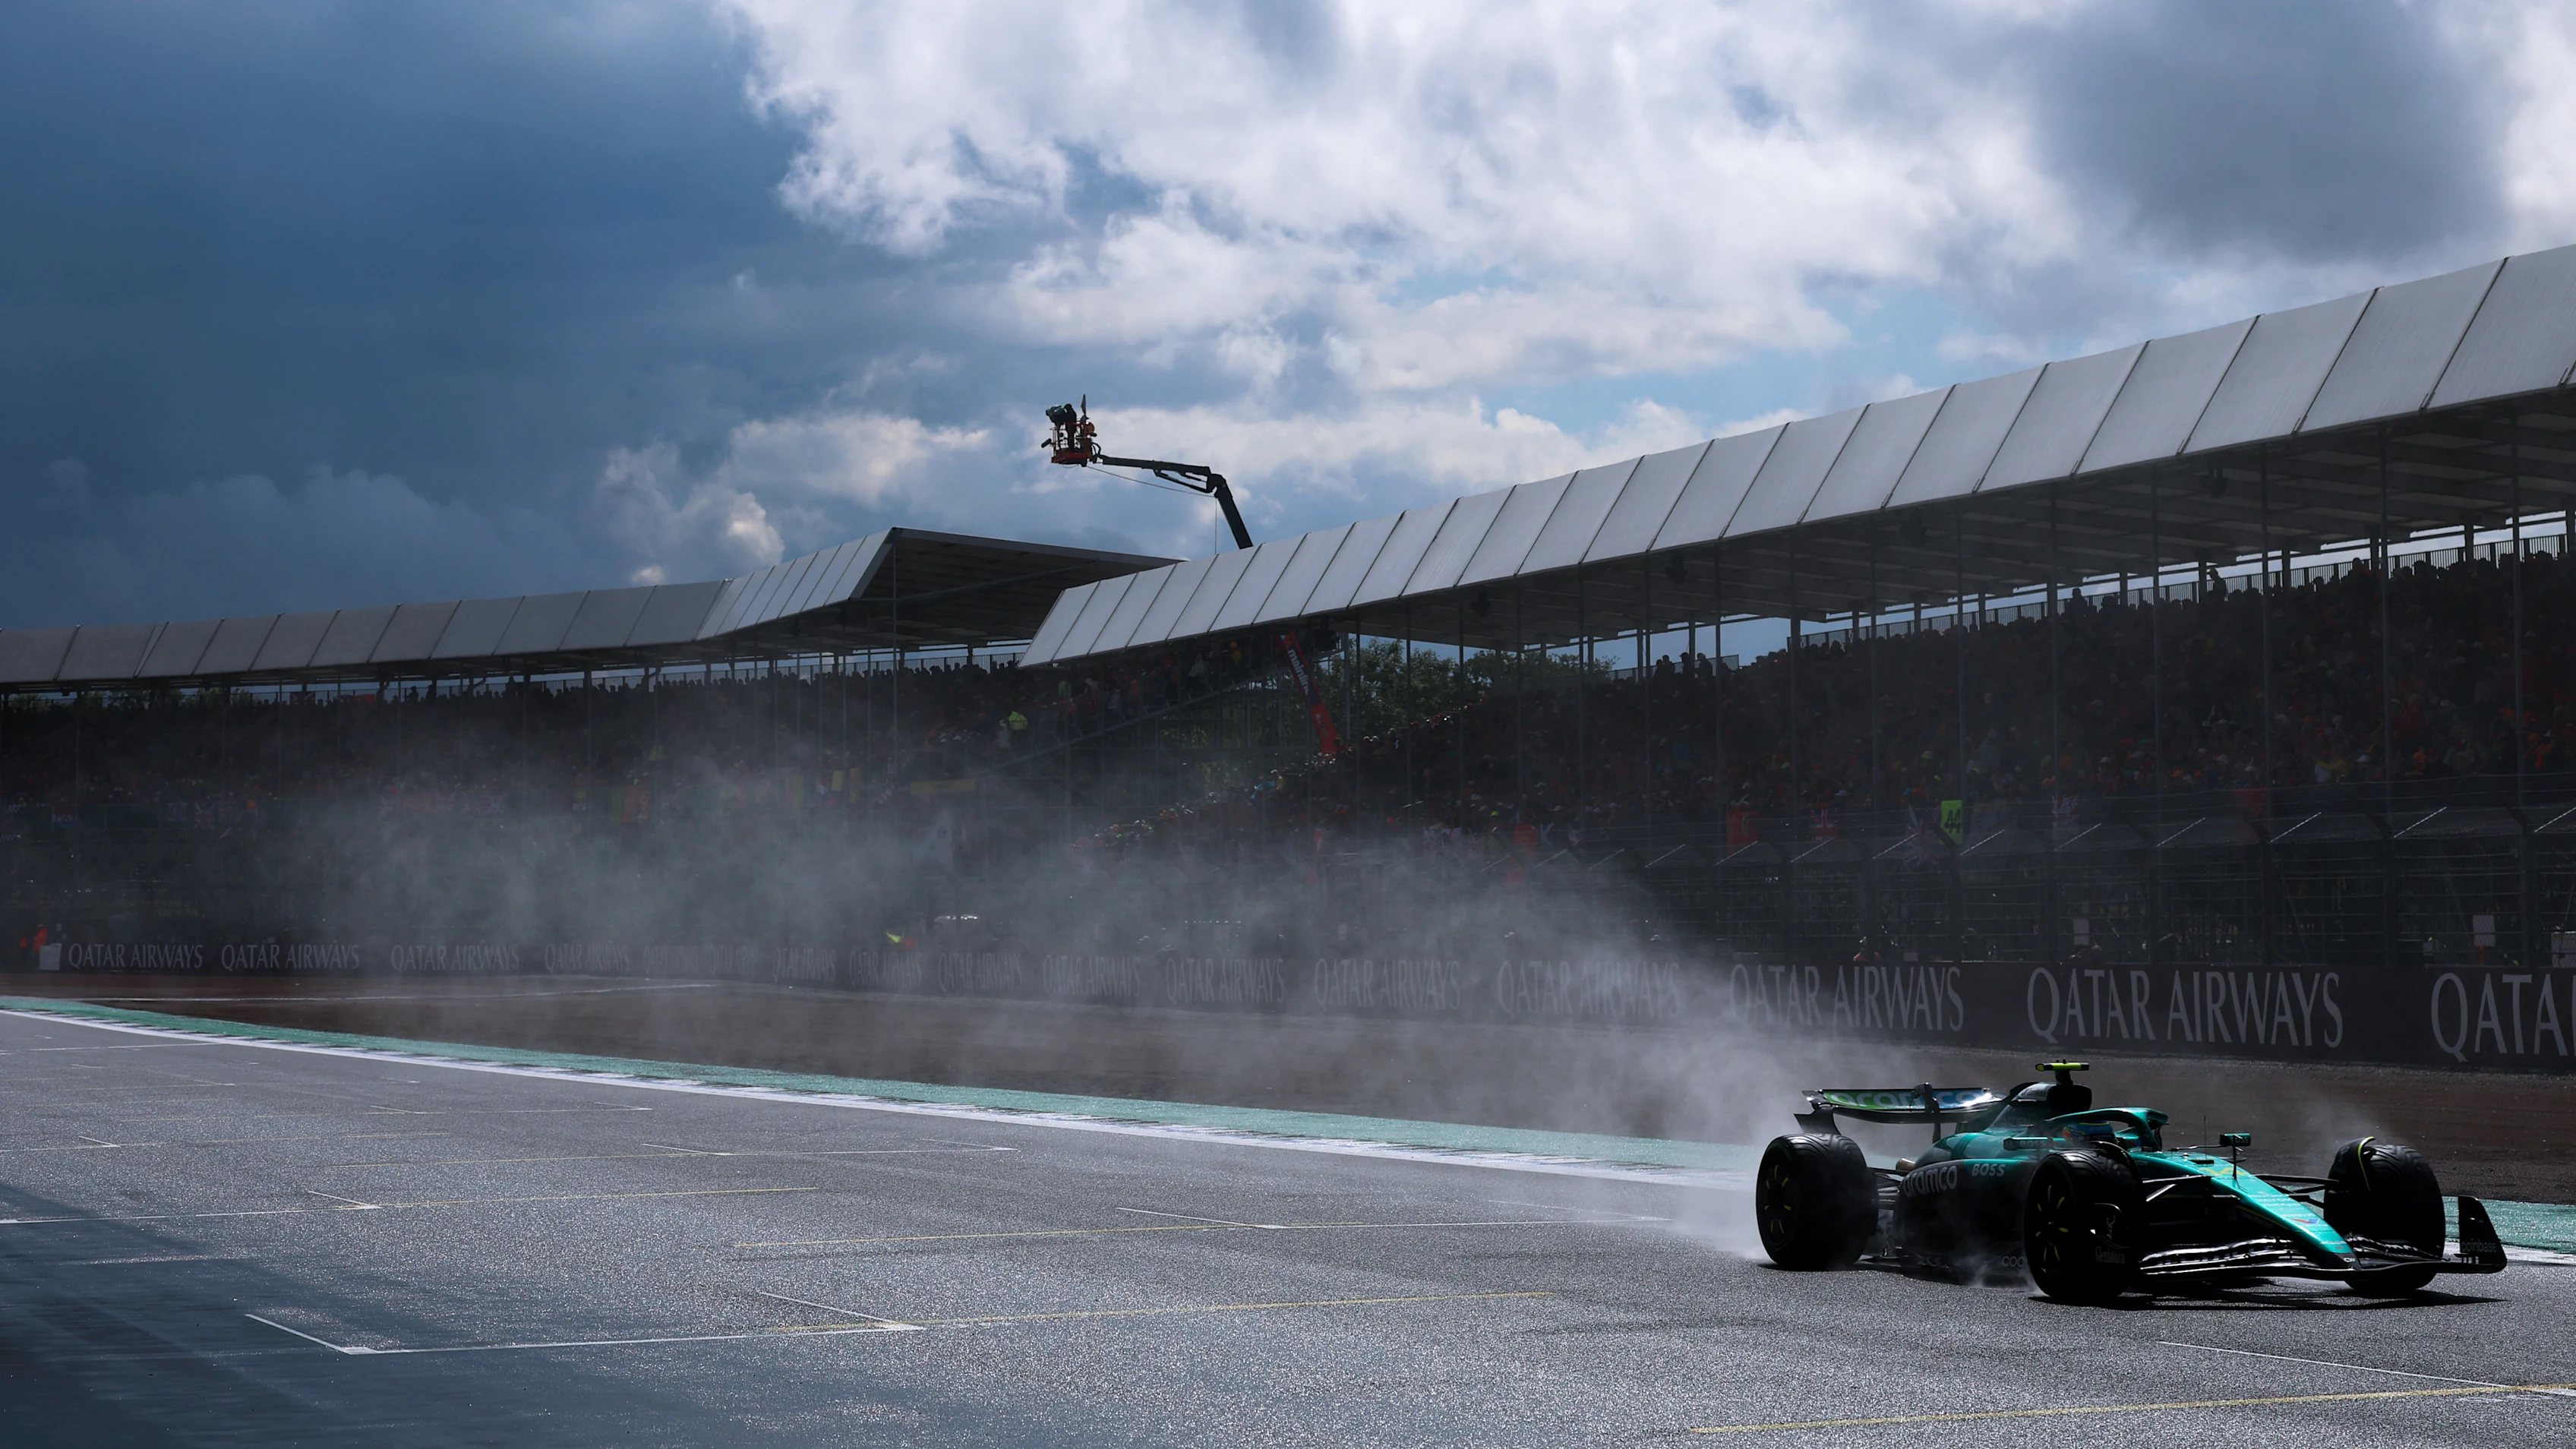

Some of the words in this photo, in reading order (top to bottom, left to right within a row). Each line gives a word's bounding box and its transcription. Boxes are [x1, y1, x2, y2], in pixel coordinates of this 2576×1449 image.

[1944, 810, 1961, 834] 44
[68, 943, 125, 969] QATAR
[131, 944, 203, 968] AIRWAYS
[220, 944, 280, 971] QATAR
[285, 944, 360, 969] AIRWAYS
[390, 945, 447, 972] QATAR
[451, 944, 519, 971] AIRWAYS
[545, 943, 582, 974] QATAR
[849, 952, 879, 988] QATAR
[939, 952, 973, 993] QATAR
[976, 952, 1022, 990] AIRWAYS
[1043, 955, 1081, 998] QATAR
[1086, 955, 1141, 998] AIRWAYS
[1166, 958, 1214, 1005] QATAR
[1218, 958, 1284, 1003] AIRWAYS
[1314, 958, 1375, 1012] QATAR
[1379, 960, 1461, 1010] AIRWAYS
[1498, 960, 1572, 1018] QATAR
[1578, 961, 1679, 1018] AIRWAYS
[1730, 963, 1823, 1030] QATAR
[1832, 966, 1965, 1031] AIRWAYS
[2027, 967, 2156, 1043] QATAR
[2167, 971, 2344, 1048] AIRWAYS
[2430, 972, 2575, 1062] QATA
[1903, 1165, 1958, 1198] aramco
[1971, 1163, 2006, 1177] BOSS
[2461, 1237, 2497, 1253] coinbase
